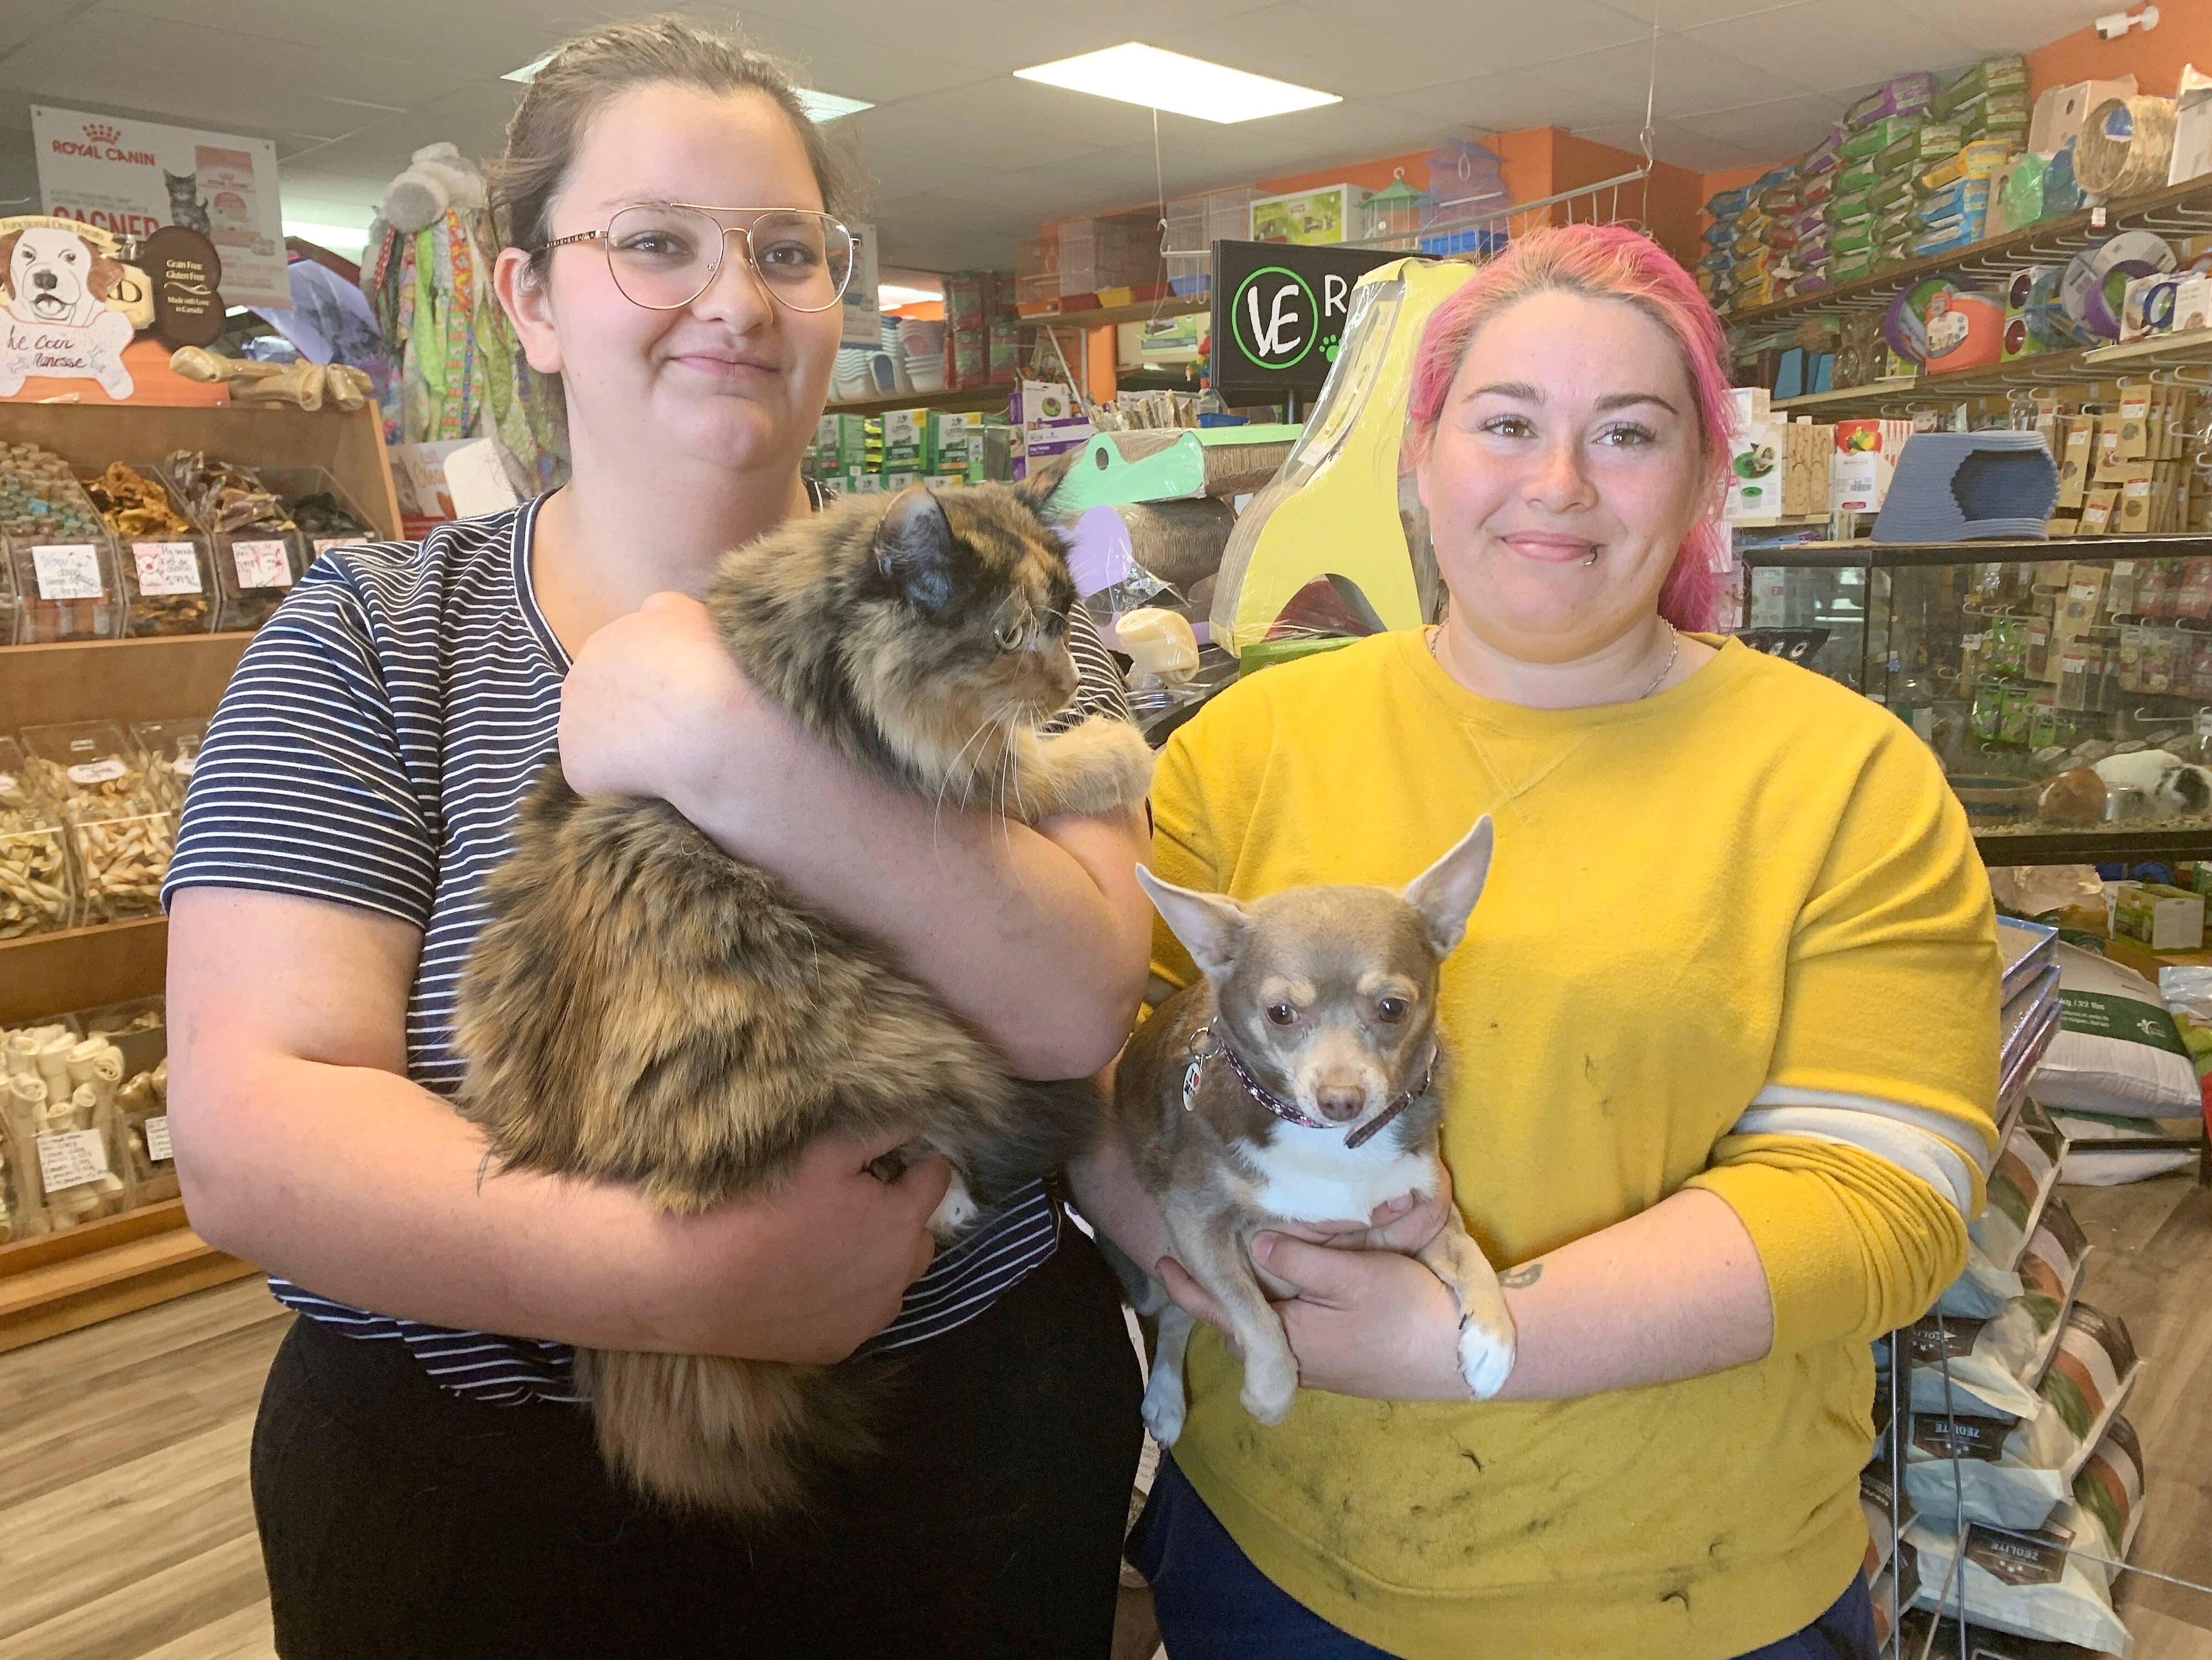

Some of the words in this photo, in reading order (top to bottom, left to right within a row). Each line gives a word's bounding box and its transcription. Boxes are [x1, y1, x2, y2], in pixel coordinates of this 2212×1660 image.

[52, 140, 103, 160] ROYAL
[105, 148, 156, 166] CANIN
[166, 259, 187, 269] Grain
[187, 261, 203, 270] Free
[165, 270, 189, 280] Gluten
[190, 272, 206, 281] Free
[1935, 1423, 1980, 1438] ZEOLTE
[1990, 1541, 2039, 1561] ZEOLITE
